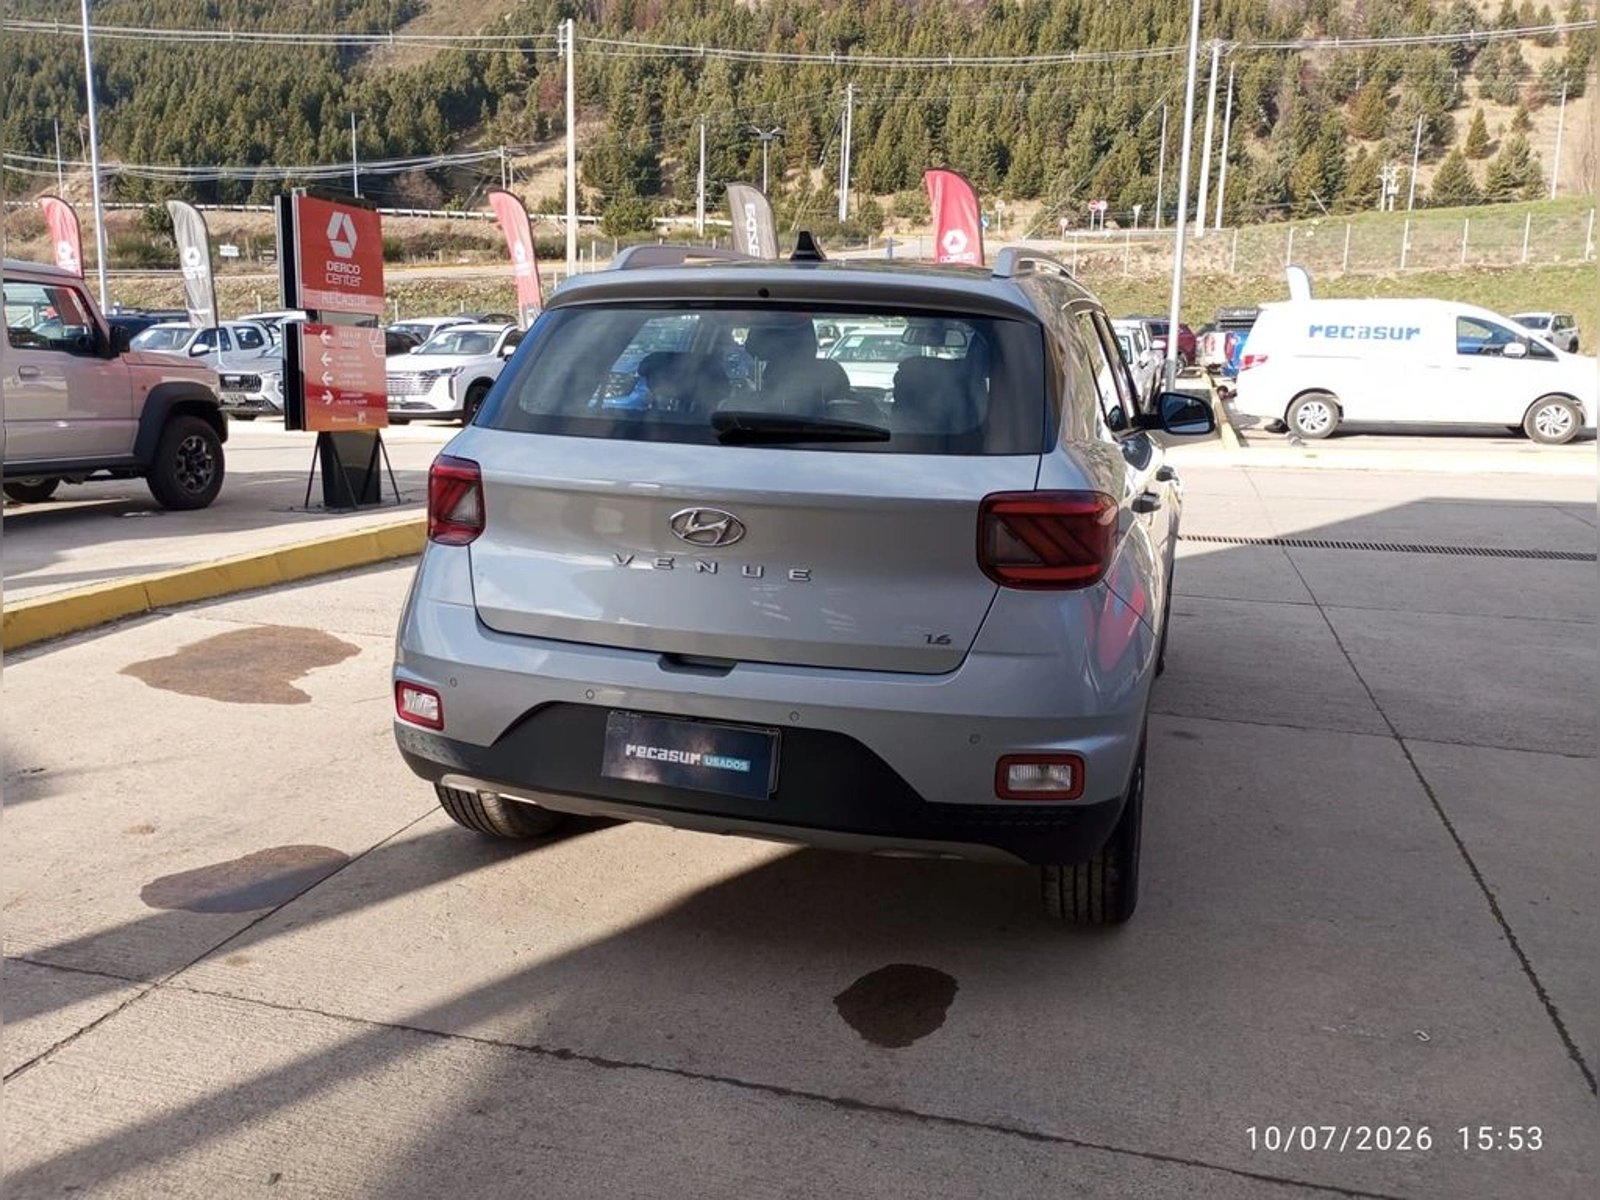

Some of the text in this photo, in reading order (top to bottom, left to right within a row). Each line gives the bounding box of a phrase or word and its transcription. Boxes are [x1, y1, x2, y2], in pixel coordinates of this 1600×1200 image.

[326, 261, 360, 275] DERCO
[326, 273, 362, 287] center
[1308, 324, 1421, 341] recasur
[612, 553, 812, 582] VENUE
[625, 743, 750, 771] recasur USADOS
